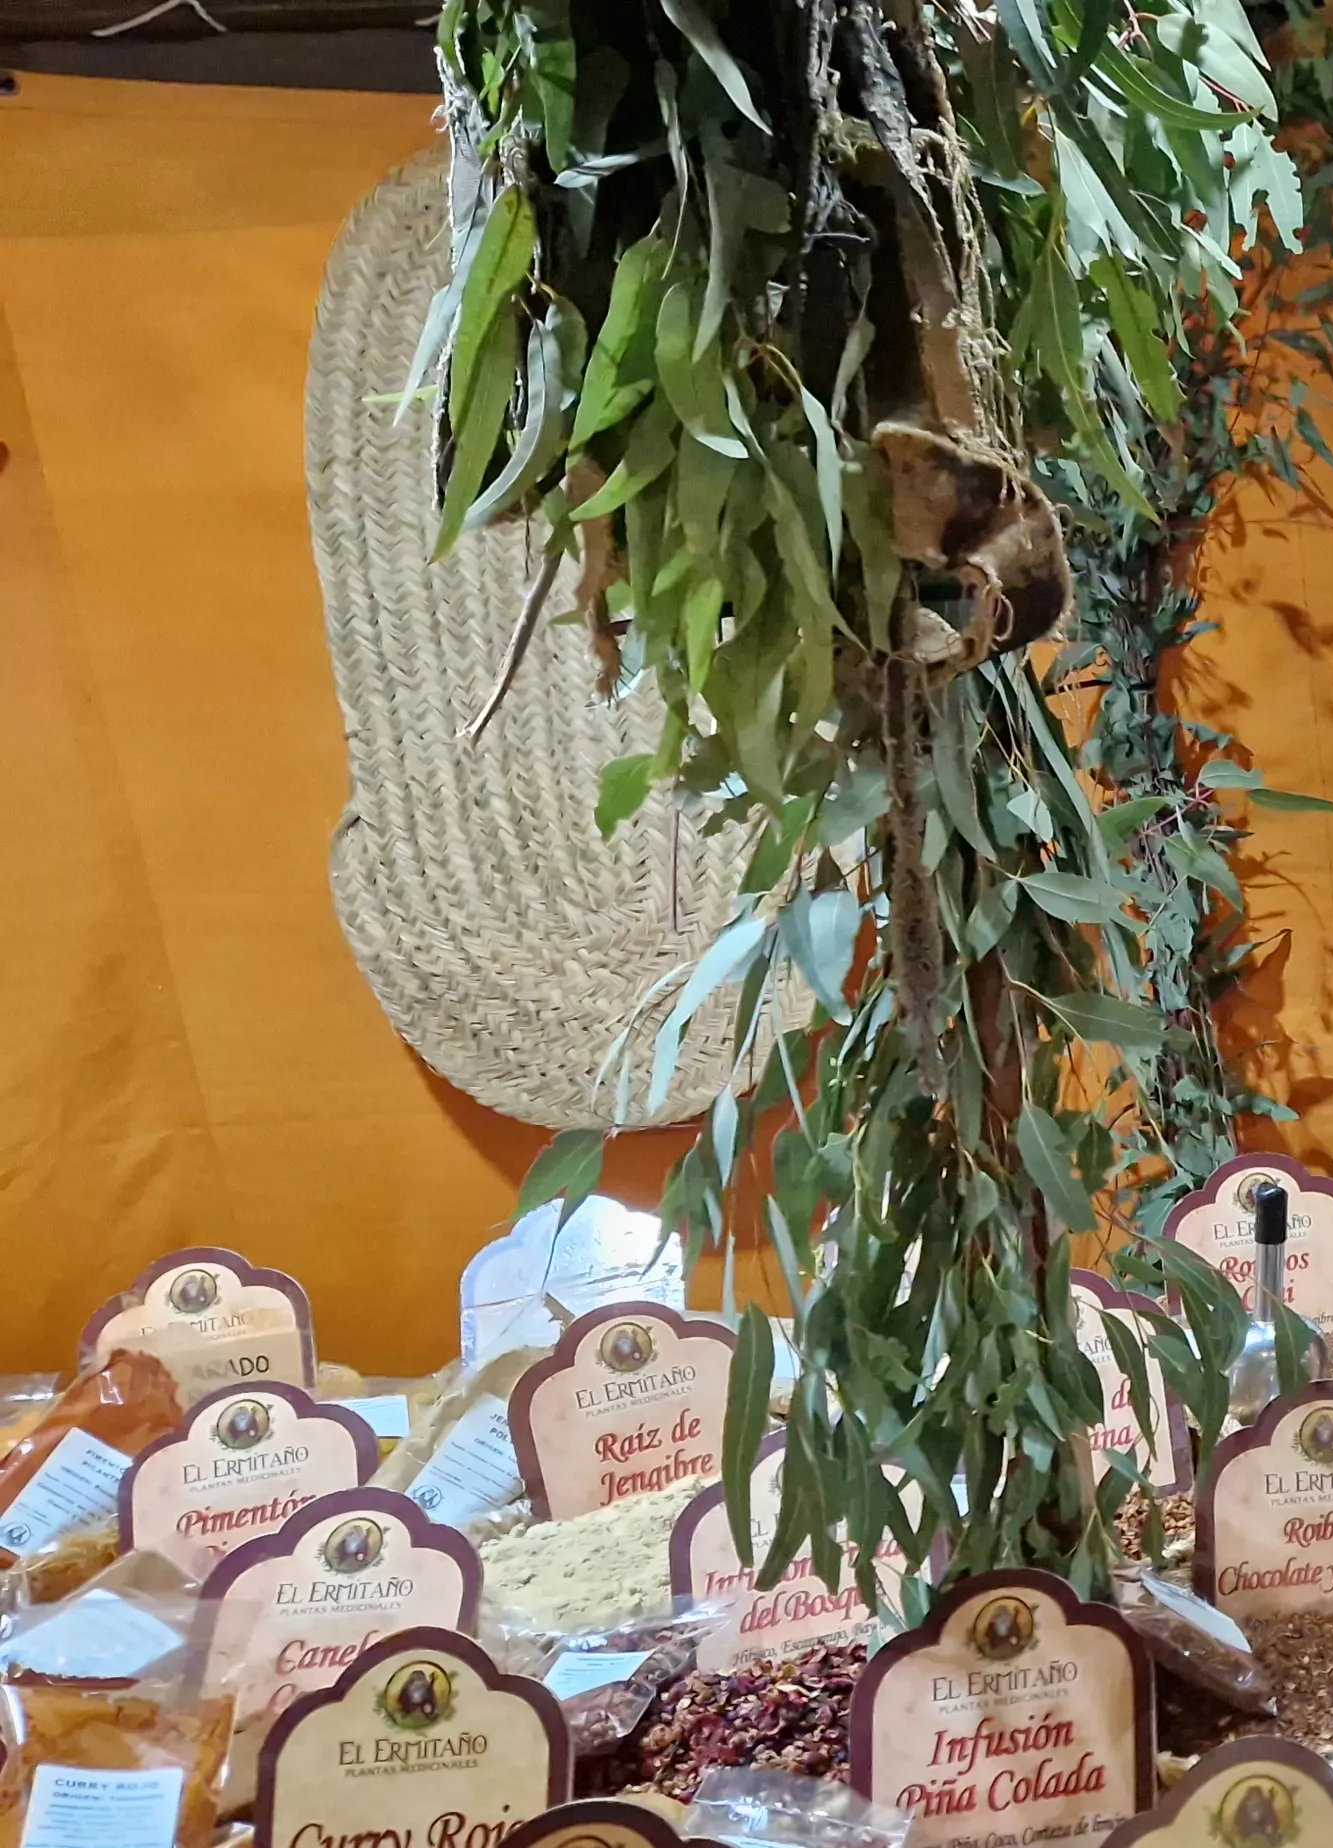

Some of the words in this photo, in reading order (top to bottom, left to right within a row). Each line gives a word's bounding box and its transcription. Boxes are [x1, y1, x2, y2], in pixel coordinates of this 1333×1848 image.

[1214, 1223, 1236, 1241] EL
[1237, 1213, 1312, 1237] ERAÑO
[575, 1389, 601, 1411] EL
[605, 1365, 696, 1403] ERMITAÑO
[594, 1422, 663, 1466] Raíz
[671, 1408, 701, 1443] de
[182, 1464, 207, 1485] EL
[213, 1446, 309, 1477] ERMITAÑO
[600, 1447, 715, 1508] Jengibre
[1265, 1473, 1290, 1495] EL
[276, 1583, 302, 1605] EL
[308, 1576, 413, 1603] ERMITAÑO
[1218, 1557, 1322, 1596] Chocolate
[279, 1606, 327, 1616] PLANTAS
[330, 1601, 402, 1613] MEDICINALES
[740, 1591, 786, 1634] del
[275, 1630, 379, 1675] Canel
[932, 1676, 961, 1702] EL
[966, 1660, 1078, 1697] ERMITAÑO
[338, 1741, 367, 1766] EL
[374, 1732, 488, 1763] ERMITAÑO
[927, 1712, 1075, 1777] Infusión
[55, 1778, 108, 1790] CURRY
[344, 1766, 396, 1778] PLANTAS
[400, 1758, 478, 1774] MEDICINALES
[896, 1778, 978, 1820] Piña
[988, 1751, 1106, 1813] Colada
